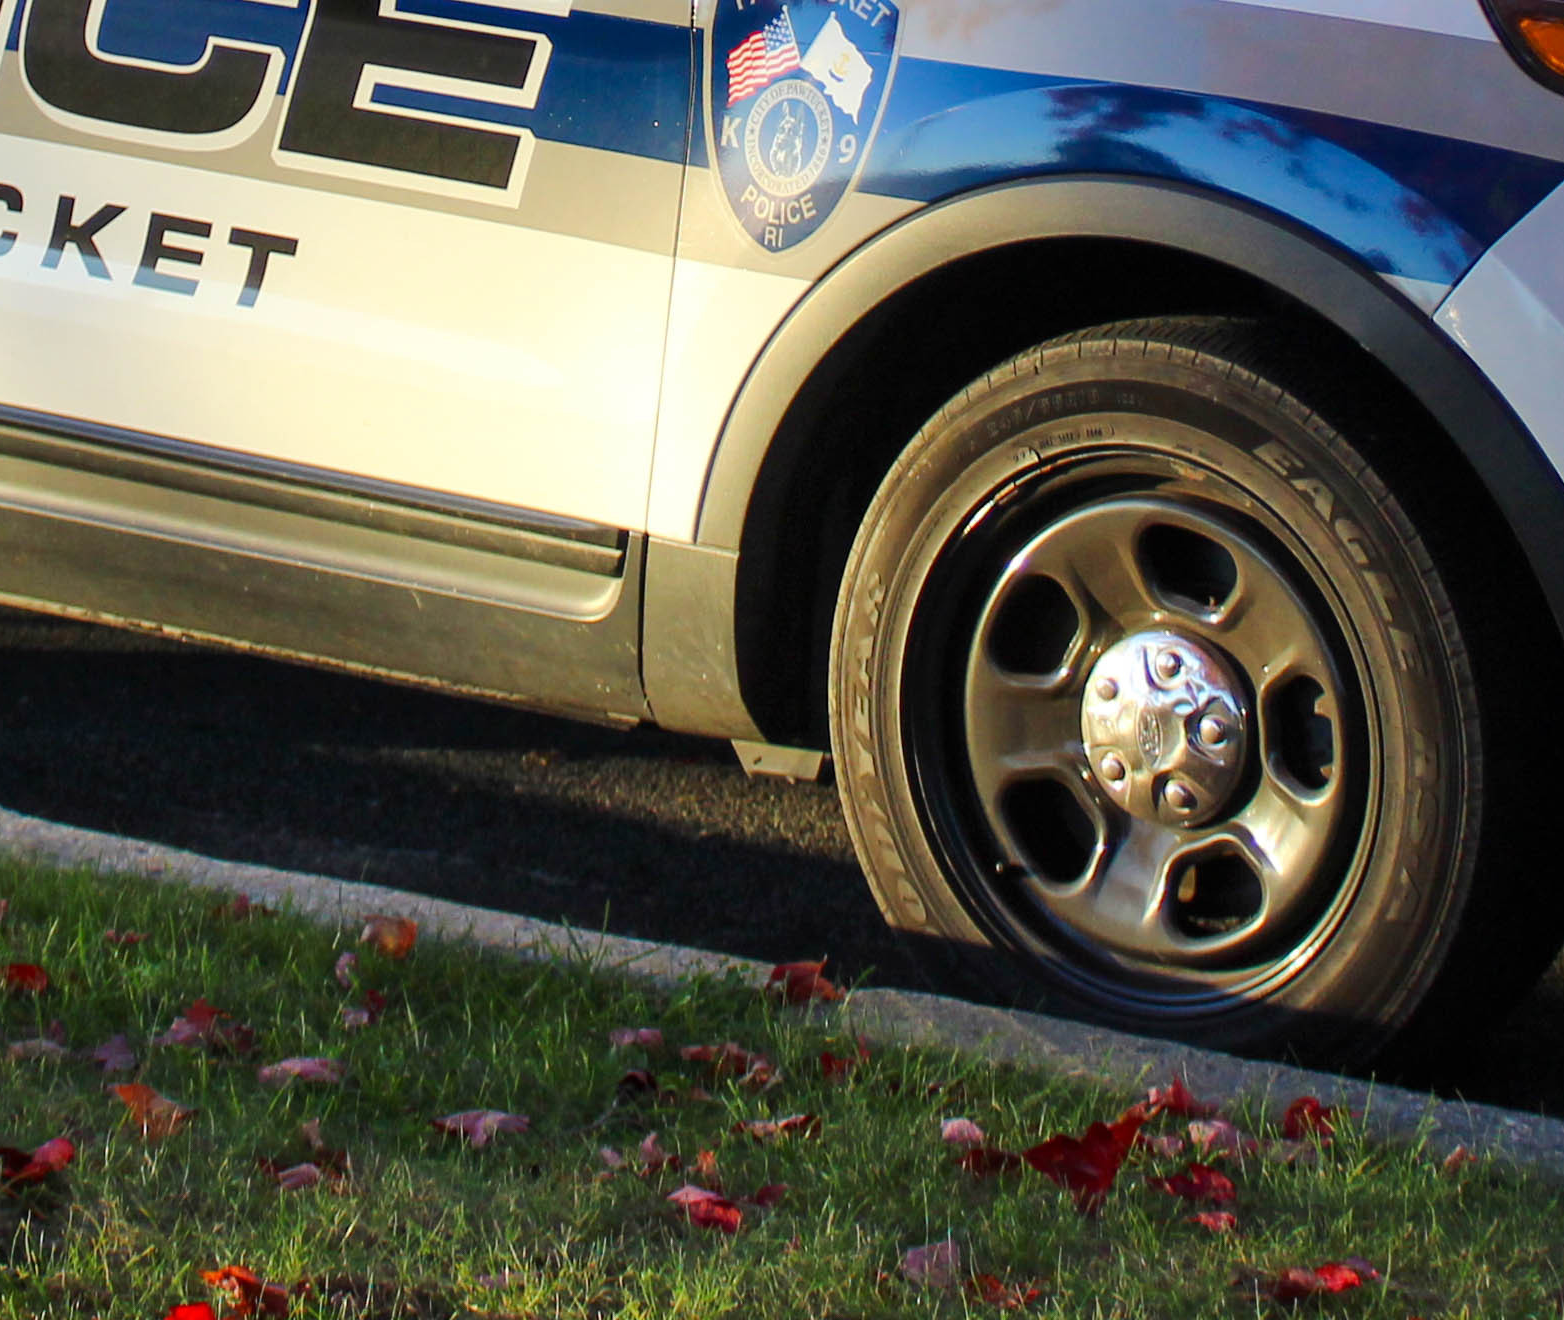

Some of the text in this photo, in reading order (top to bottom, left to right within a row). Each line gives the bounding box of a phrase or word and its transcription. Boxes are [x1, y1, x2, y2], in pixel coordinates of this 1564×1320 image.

[720, 114, 859, 164] K 9
[740, 183, 818, 226] POLICE
[763, 226, 784, 249] RI
[1252, 438, 1425, 674] EAGLE
